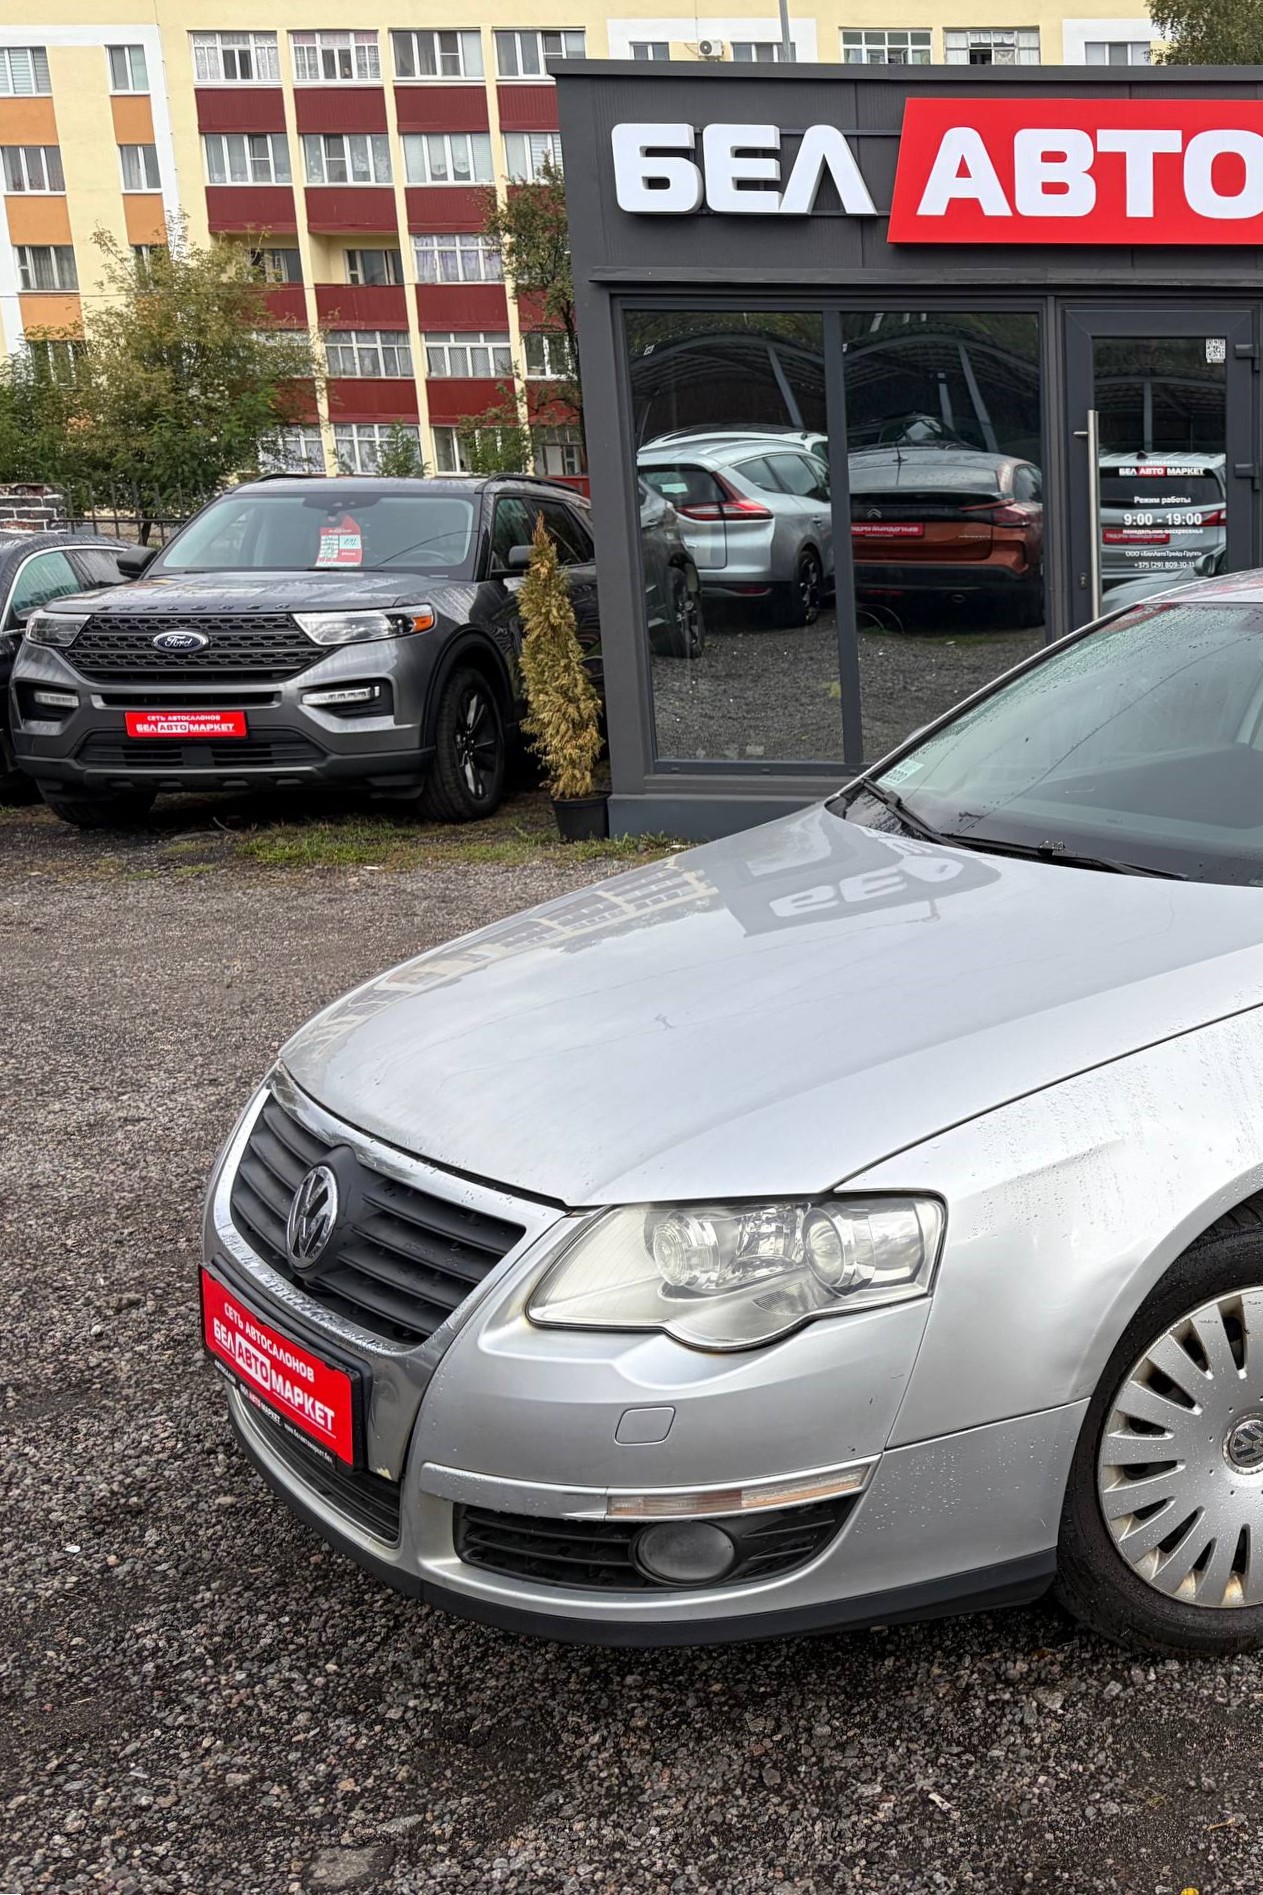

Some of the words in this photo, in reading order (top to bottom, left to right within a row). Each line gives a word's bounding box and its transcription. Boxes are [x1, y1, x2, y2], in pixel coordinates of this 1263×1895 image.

[611, 123, 878, 214] БЕЛ
[1119, 468, 1137, 476] БЕЛ
[1140, 467, 1164, 475] АВТО
[1167, 467, 1205, 475] МАРКЕТ
[1134, 496, 1160, 504] Режим
[1161, 496, 1192, 505] работы
[1123, 513, 1153, 526] 9:00
[1165, 513, 1203, 525] 19:00
[164, 635, 193, 648] Ford
[159, 723, 187, 732] АВТО
[189, 723, 235, 732] МАРКЕТ
[223, 1302, 245, 1331] СЕТЬ
[245, 1321, 315, 1383] АВТОСАЛОНОВ
[213, 1317, 235, 1354] БЕЛ
[236, 1336, 270, 1387] АВТО
[270, 1369, 336, 1432] МАРКЕТ
